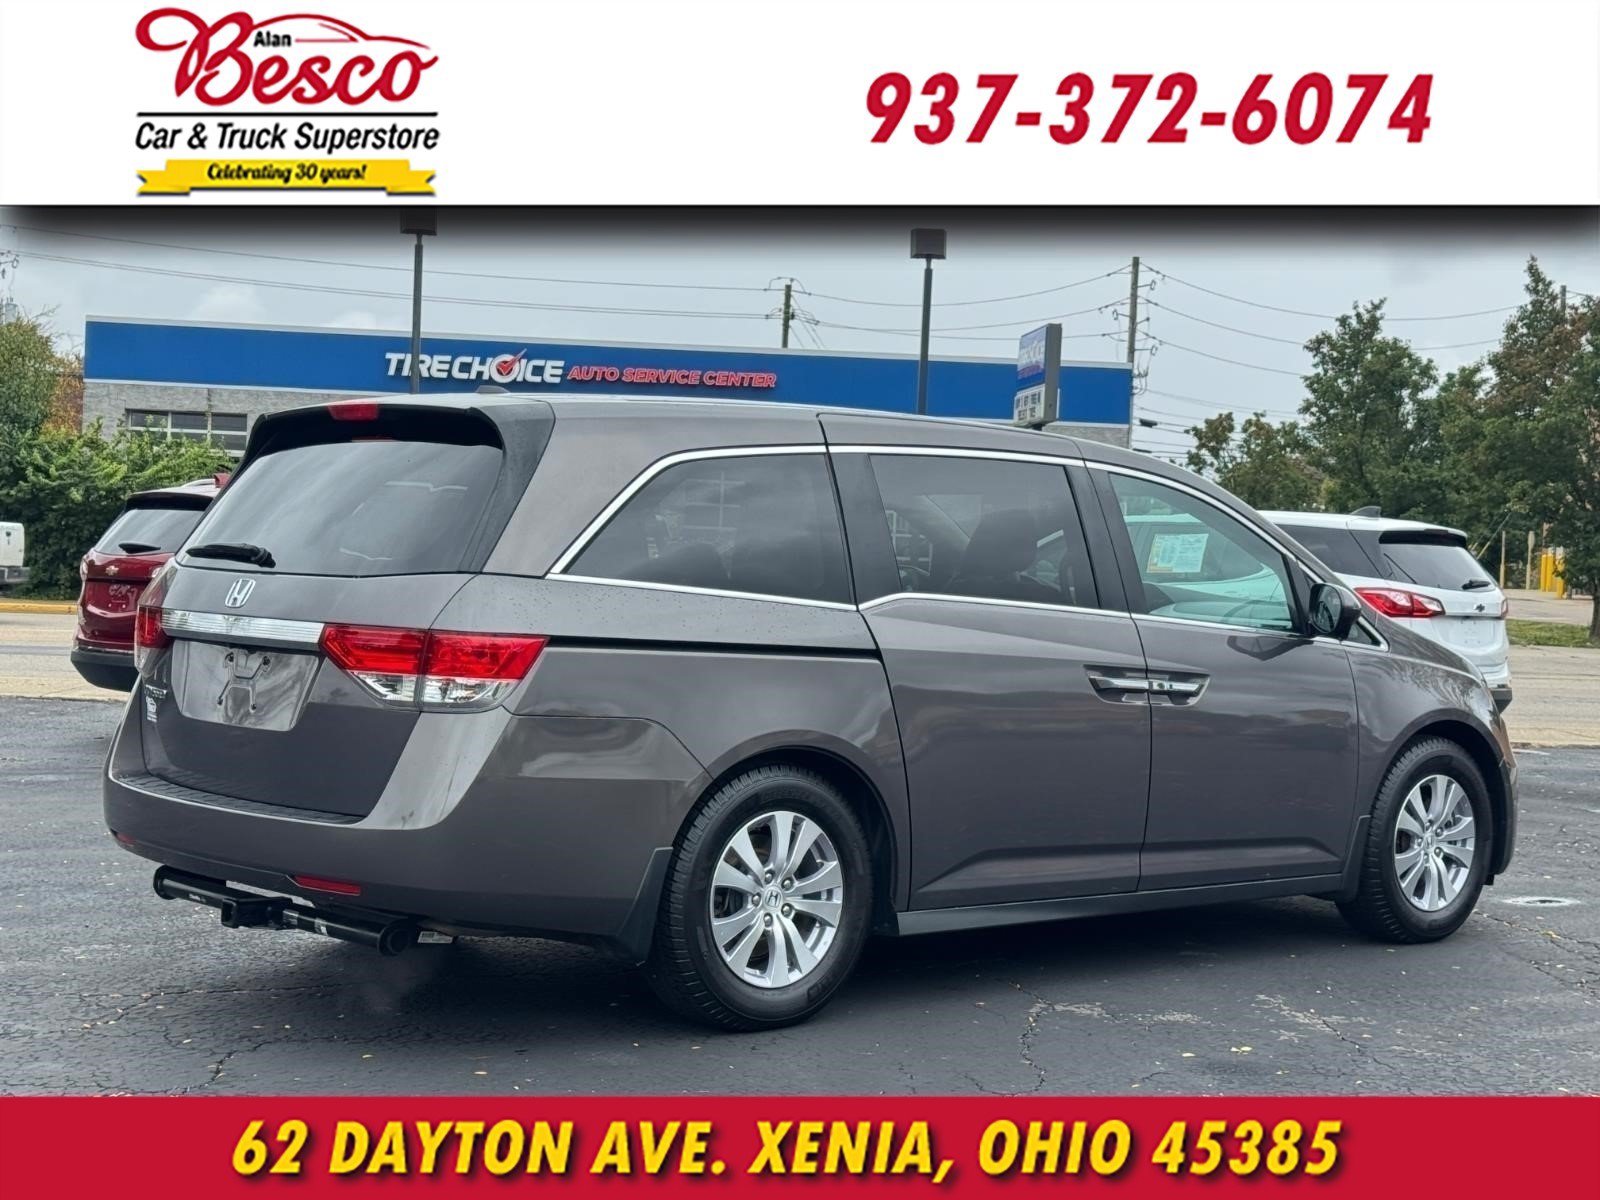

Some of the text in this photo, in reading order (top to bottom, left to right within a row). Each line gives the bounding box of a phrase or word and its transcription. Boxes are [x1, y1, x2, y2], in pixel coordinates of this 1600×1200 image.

[567, 366, 777, 388] AUTO SERVICE CENTER
